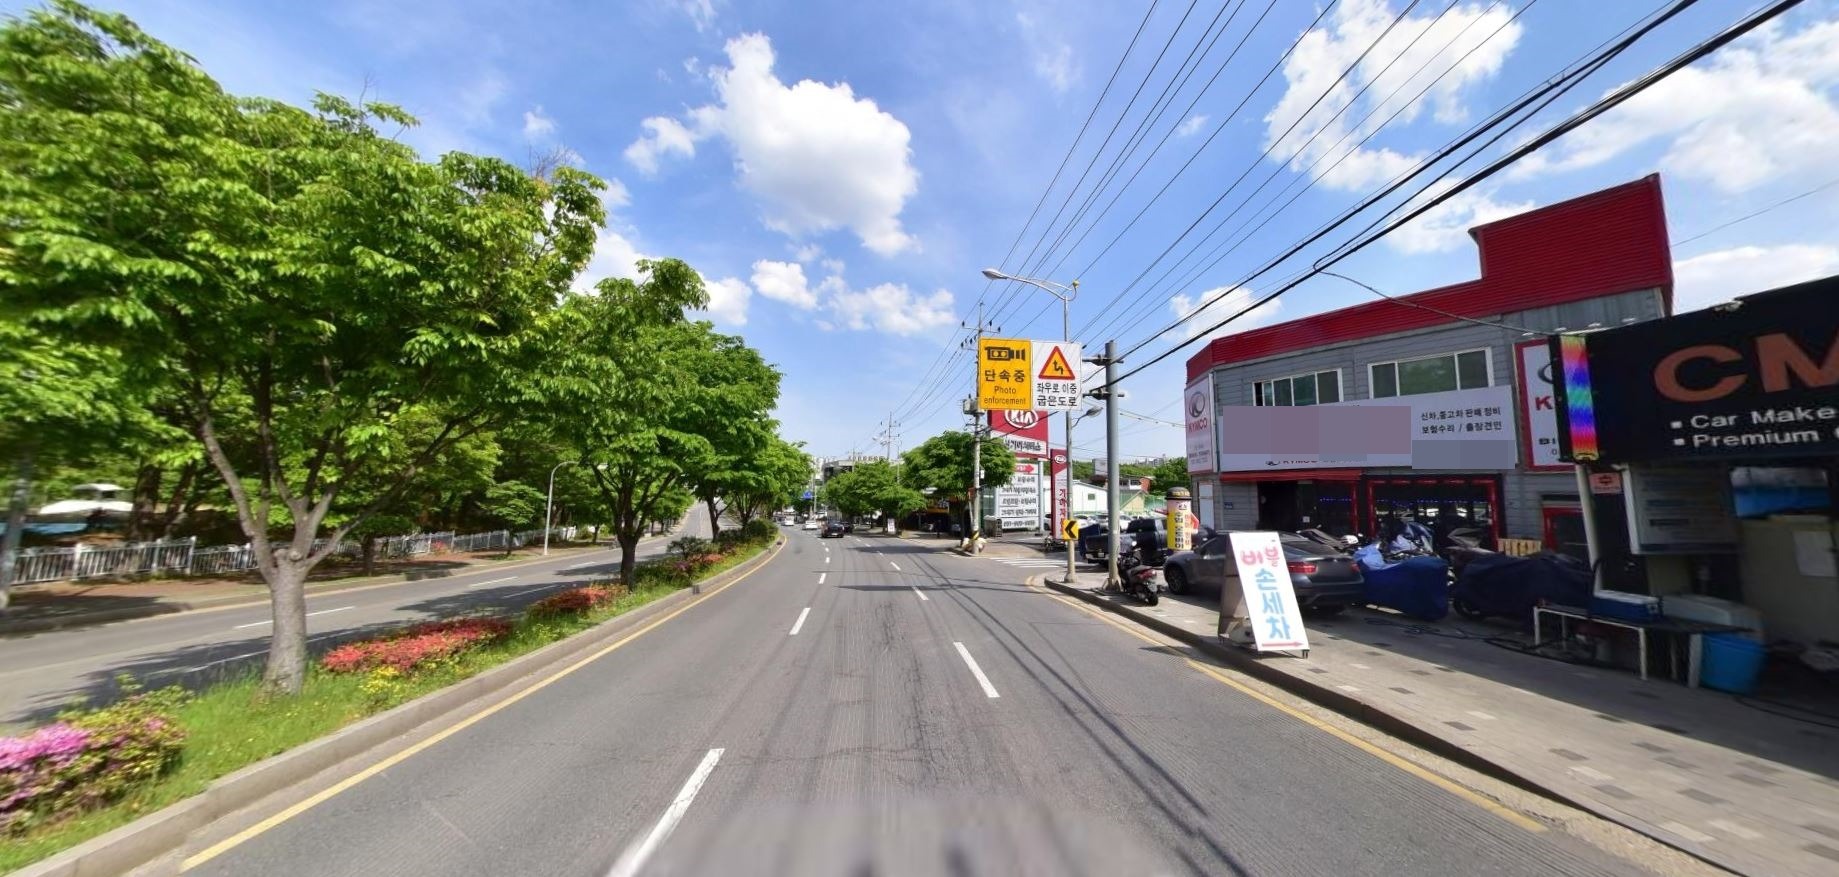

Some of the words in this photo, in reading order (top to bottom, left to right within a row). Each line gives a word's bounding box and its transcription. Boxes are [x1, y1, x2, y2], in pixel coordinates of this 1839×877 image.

[984, 369, 1025, 383] 단속중
[994, 386, 1017, 395] Photo
[1037, 383, 1060, 394] 좌우로
[1062, 383, 1077, 394] 이중
[984, 396, 1026, 405] enforcement
[1037, 395, 1077, 407] 굽은도로
[1011, 410, 1033, 423] KIA
[1465, 408, 1482, 418] 판매
[1484, 407, 1501, 417] 정비
[1422, 424, 1455, 434] 보험수리
[1466, 420, 1502, 432] 출장견인
[1690, 414, 1738, 429] Car
[1692, 429, 1820, 448] Premium
[1255, 568, 1291, 640] 손세차
